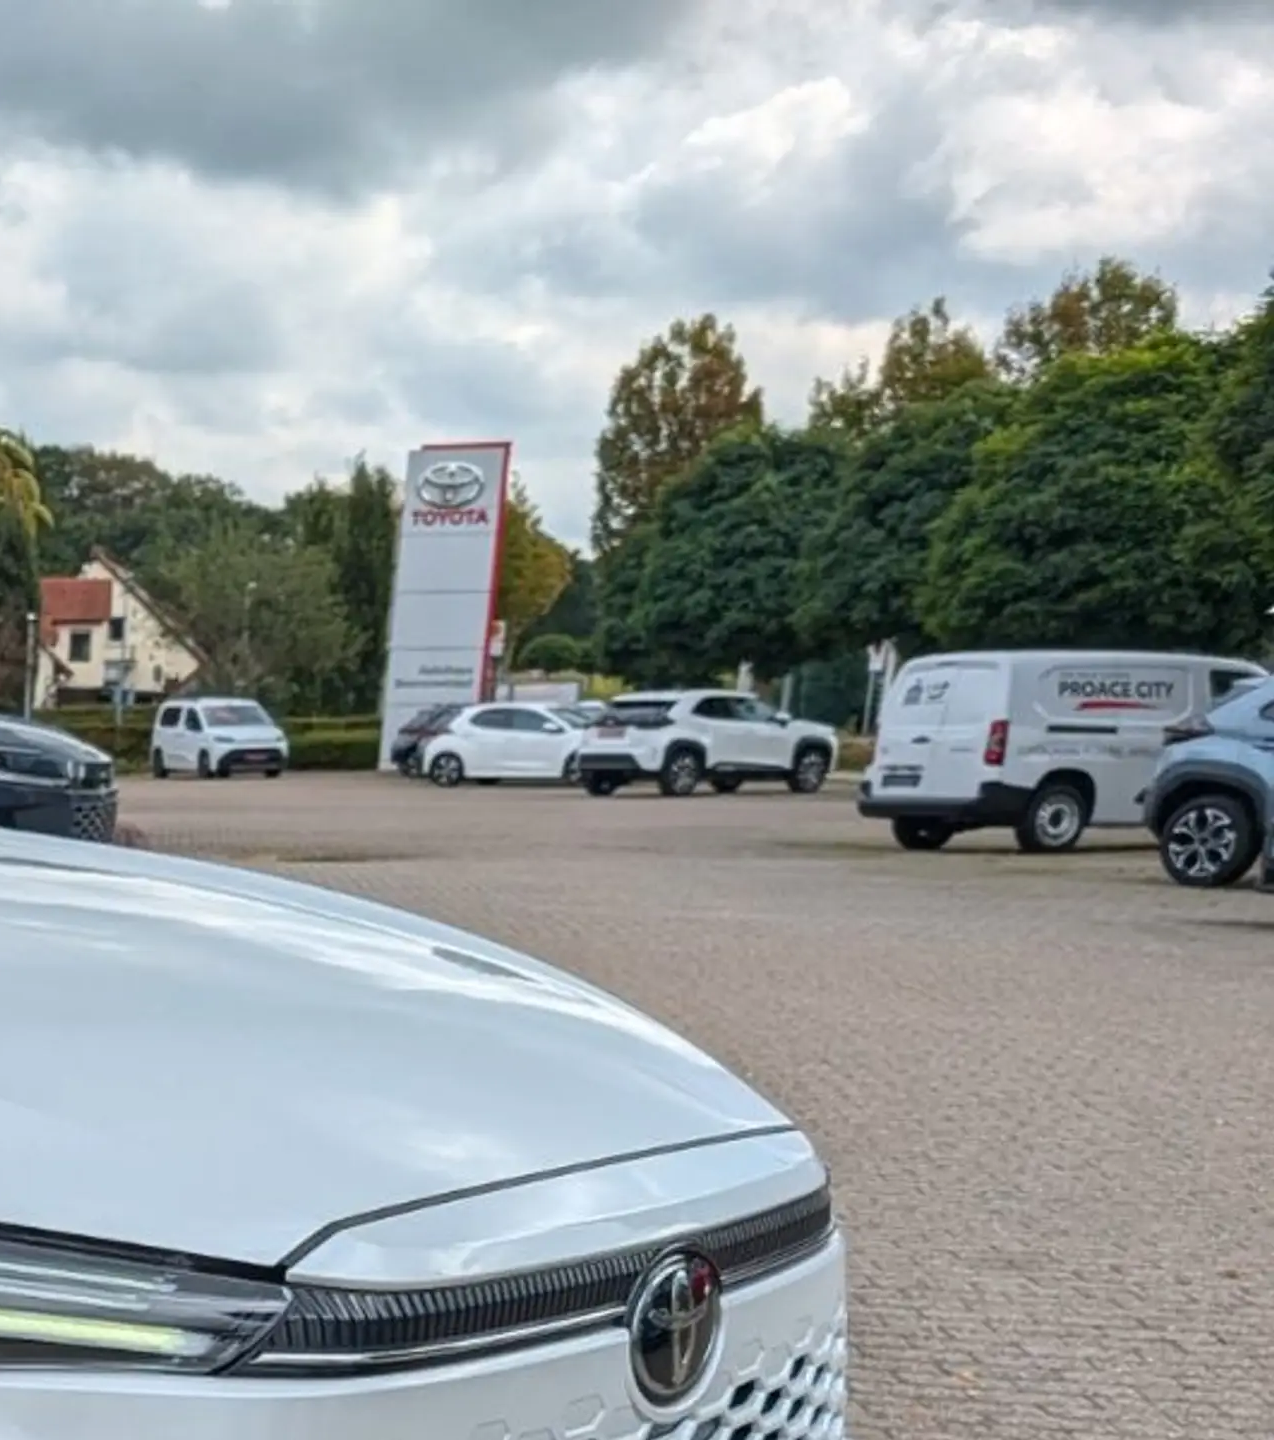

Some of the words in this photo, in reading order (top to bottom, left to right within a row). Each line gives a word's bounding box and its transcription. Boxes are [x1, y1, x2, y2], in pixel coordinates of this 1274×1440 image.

[412, 508, 489, 526] TOYOTA
[1057, 680, 1132, 698] PROACE
[1135, 681, 1175, 698] CITY
